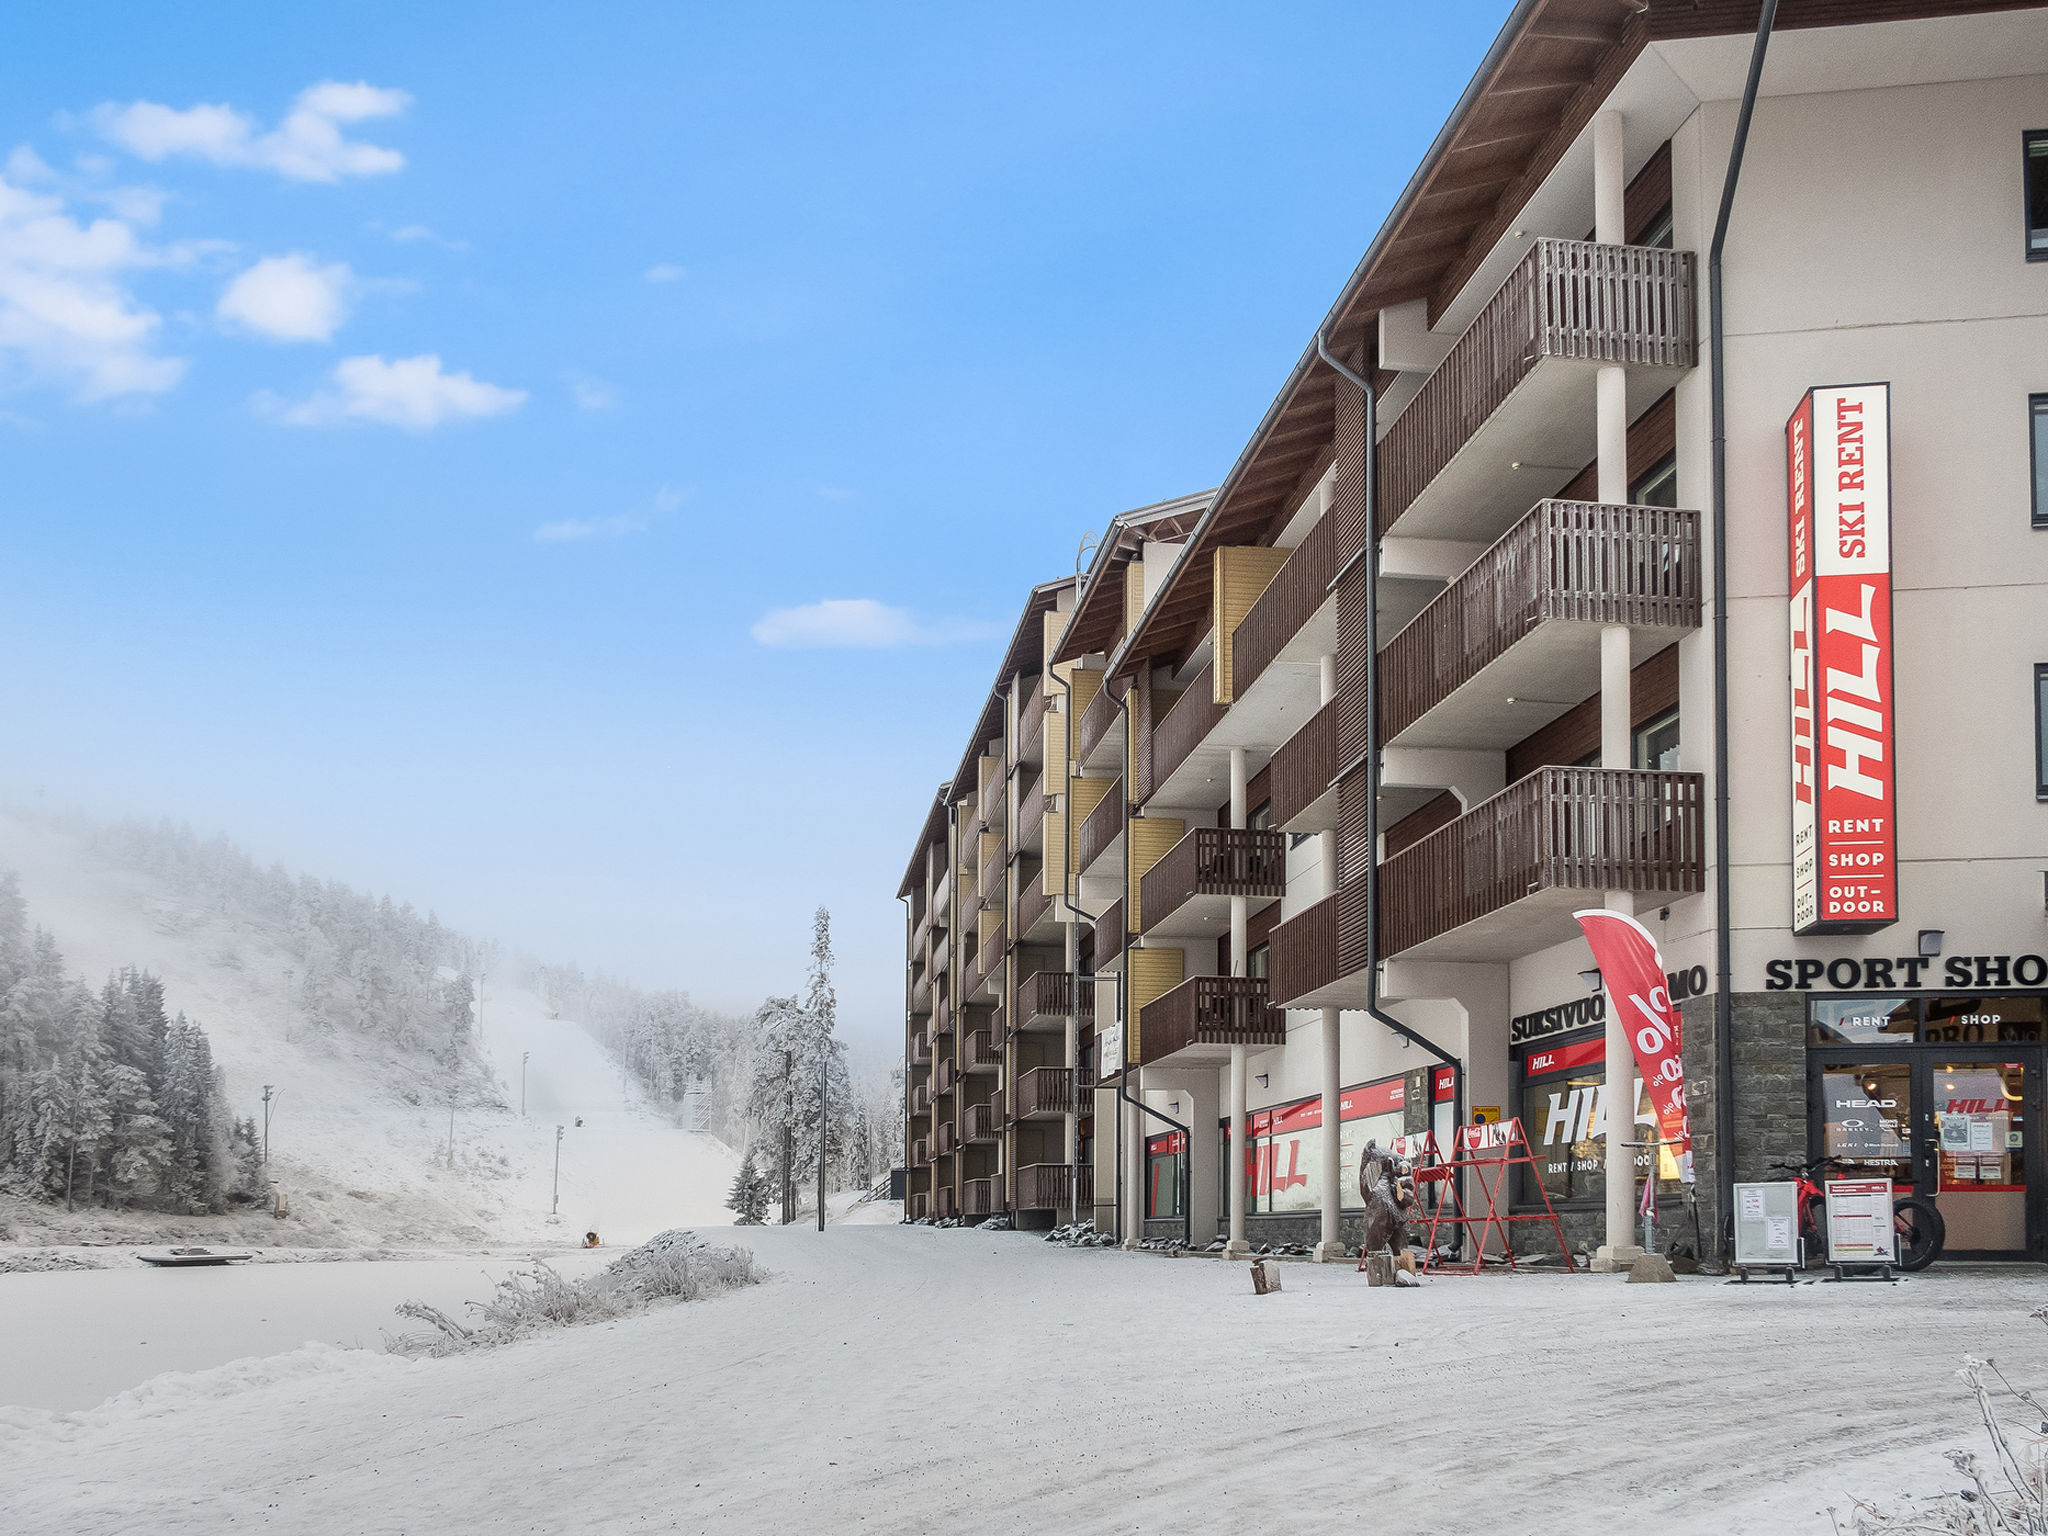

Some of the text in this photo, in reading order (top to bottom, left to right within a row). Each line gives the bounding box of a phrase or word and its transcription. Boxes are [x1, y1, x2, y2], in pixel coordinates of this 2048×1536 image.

[1836, 397, 1866, 559] SKI RENT
[1793, 417, 1806, 578] SKI RENT
[1825, 583, 1884, 801] HILL
[1793, 596, 1812, 806] HILL
[1828, 818, 1884, 834] RENT
[1795, 823, 1813, 846] RENT
[1795, 857, 1813, 878] SHOP
[1828, 852, 1885, 867] SHOP
[1828, 885, 1881, 899] OUT-
[1796, 904, 1813, 924] DOOR
[1828, 900, 1885, 914] DOOR
[1765, 954, 2048, 991] SPORT SHO
[1852, 1016, 1891, 1027] RENT
[1961, 1014, 2001, 1025] SHOP
[1532, 1054, 1555, 1071] HILL
[1835, 1099, 1897, 1108] HEAD
[1946, 1098, 2013, 1114] HILL
[1548, 1162, 1567, 1174] RENT
[1577, 1159, 1598, 1172] SHOP
